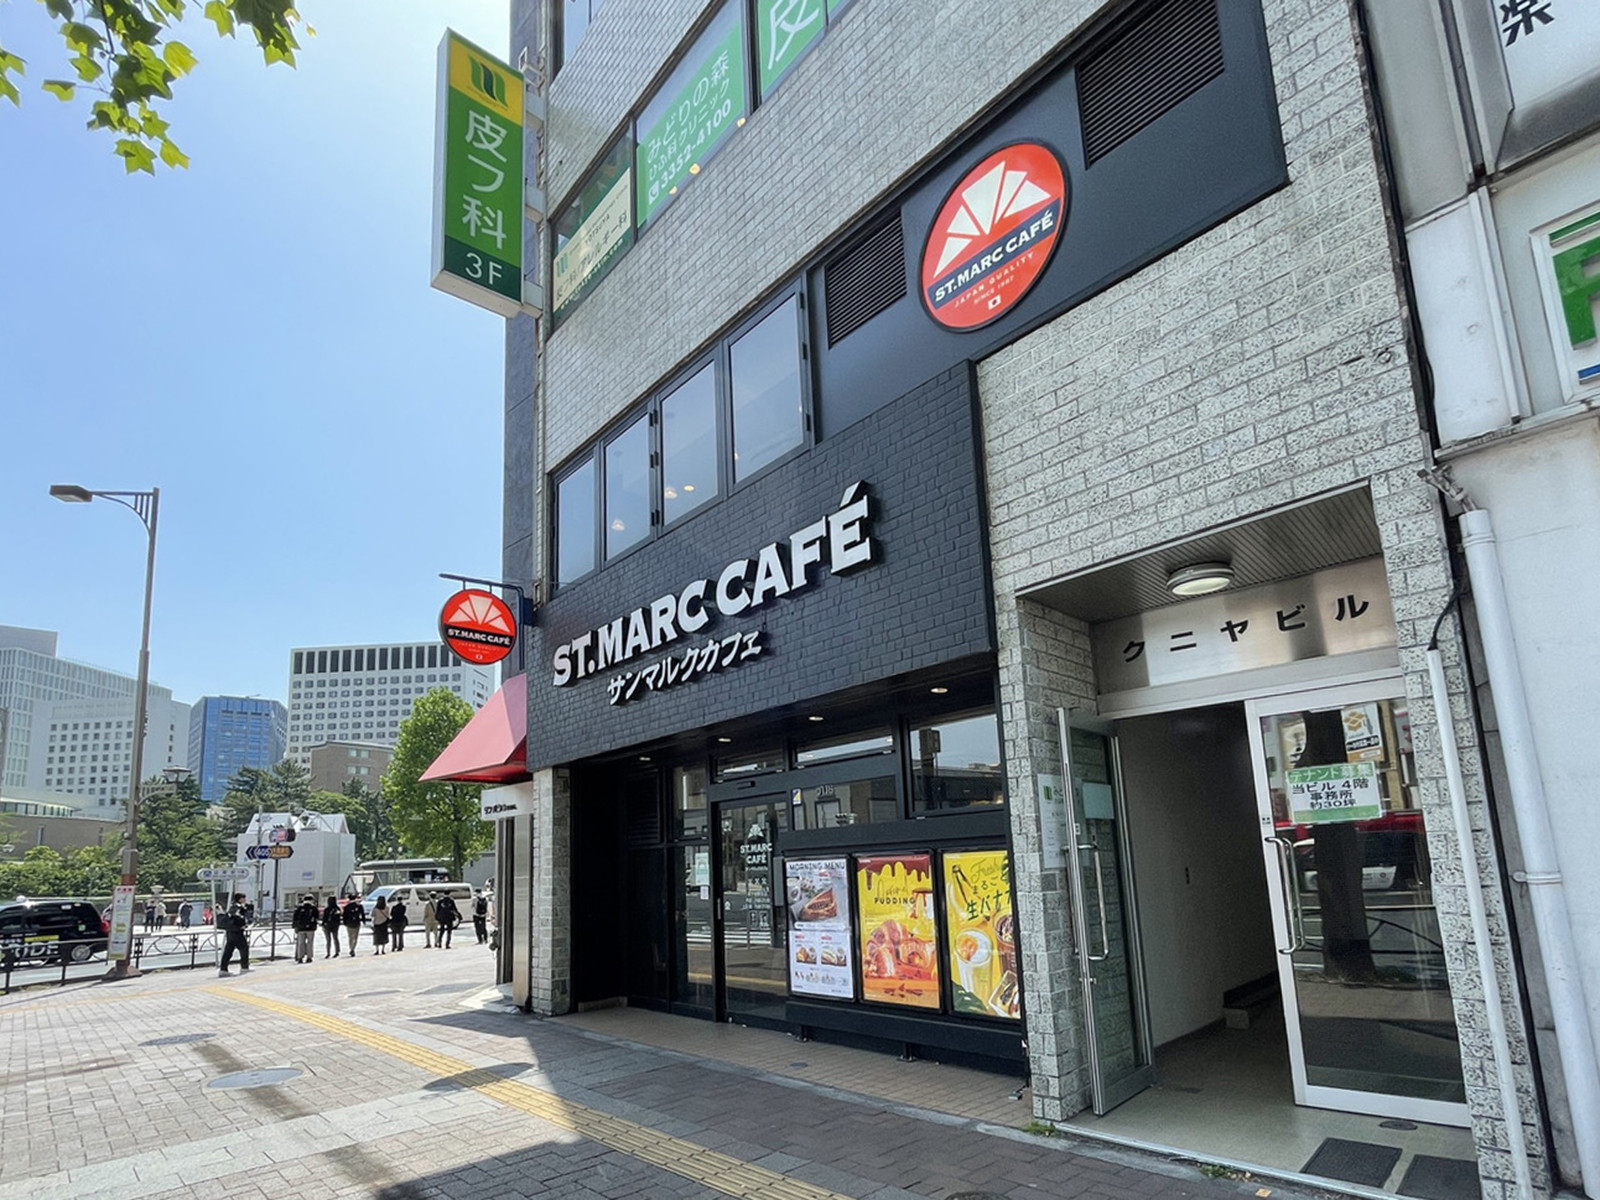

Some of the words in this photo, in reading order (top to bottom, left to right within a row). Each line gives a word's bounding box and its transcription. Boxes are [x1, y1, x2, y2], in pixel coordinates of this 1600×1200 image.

[648, 50, 728, 164] みどりの森
[661, 98, 731, 190] 3352-4100
[462, 109, 507, 250] 皮フ科
[465, 252, 502, 285] 3F
[935, 247, 1003, 302] ST.MARC
[1006, 210, 1053, 253] CAFÉ
[954, 284, 985, 307] JAPAN
[989, 252, 1033, 284] QUALITY
[553, 579, 709, 687] ST.MARC
[716, 480, 873, 616] CAFÉ
[447, 628, 486, 642] ST.MARC
[487, 635, 511, 646] CAFÉ
[1123, 594, 1369, 663] クニヤビル
[607, 630, 764, 706] サンマルクカフェ
[1290, 765, 1373, 783] テナント募集
[1292, 782, 1336, 795] 当ビル
[1342, 778, 1370, 790] 4階
[1309, 799, 1357, 810] 約30坪
[1310, 790, 1353, 802] 事務所
[740, 842, 773, 854] ST.MARC
[746, 854, 767, 865] CAFÉ
[789, 862, 823, 872] MORNING
[824, 861, 845, 870] MENU
[874, 896, 916, 905] PUDDING
